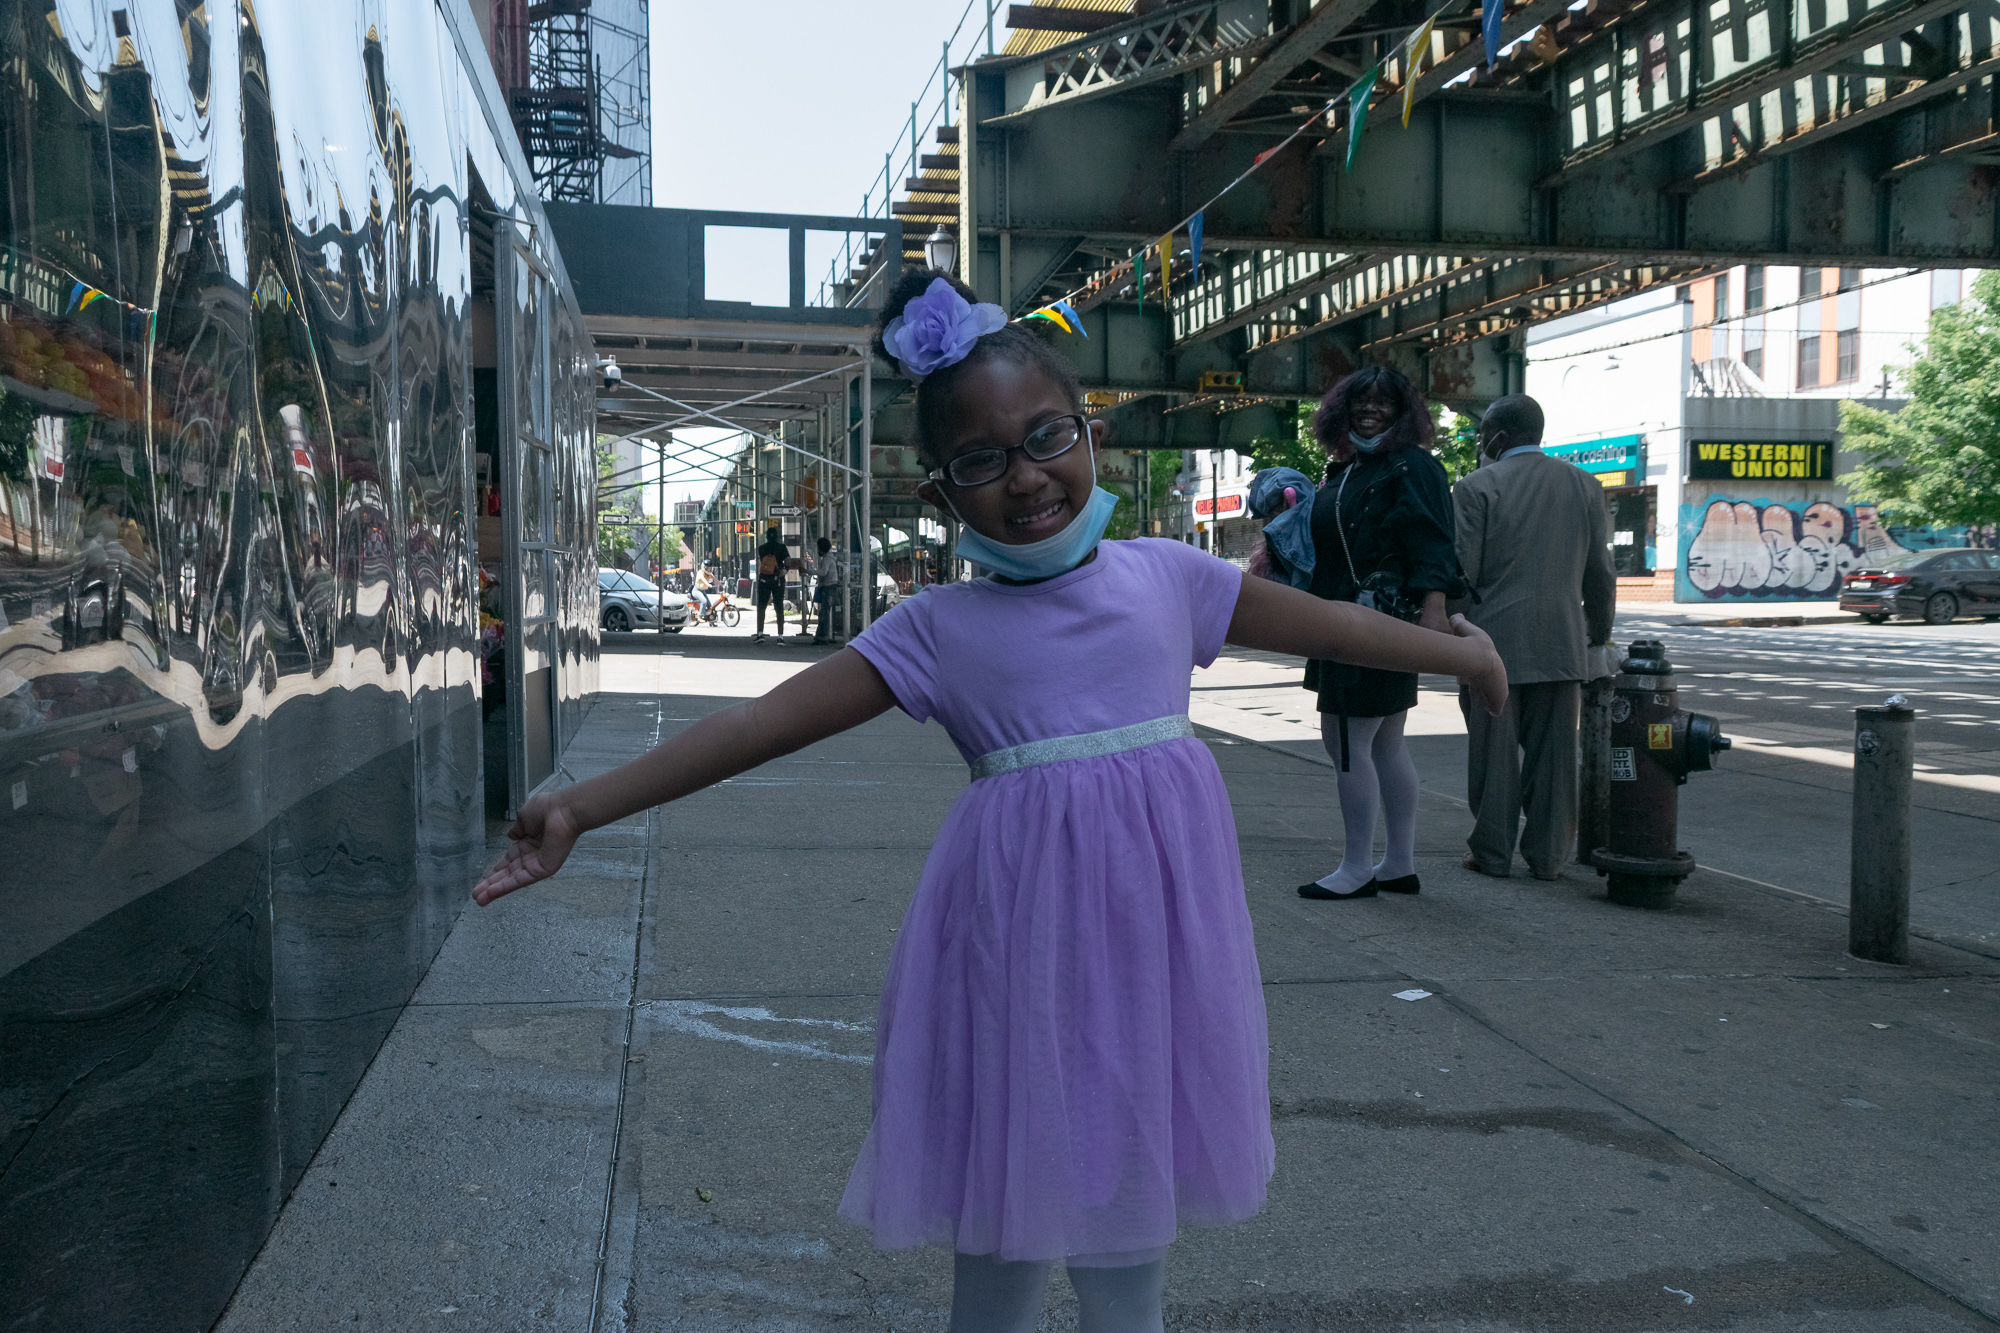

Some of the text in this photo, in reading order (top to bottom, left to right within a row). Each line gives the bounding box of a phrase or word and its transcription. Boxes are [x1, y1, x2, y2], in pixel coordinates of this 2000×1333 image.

[1582, 444, 1627, 464] cashing
[1698, 443, 1806, 460] WESTERN
[1731, 461, 1805, 478] UNION
[1612, 750, 1629, 759] RED
[1612, 760, 1630, 768] EYE
